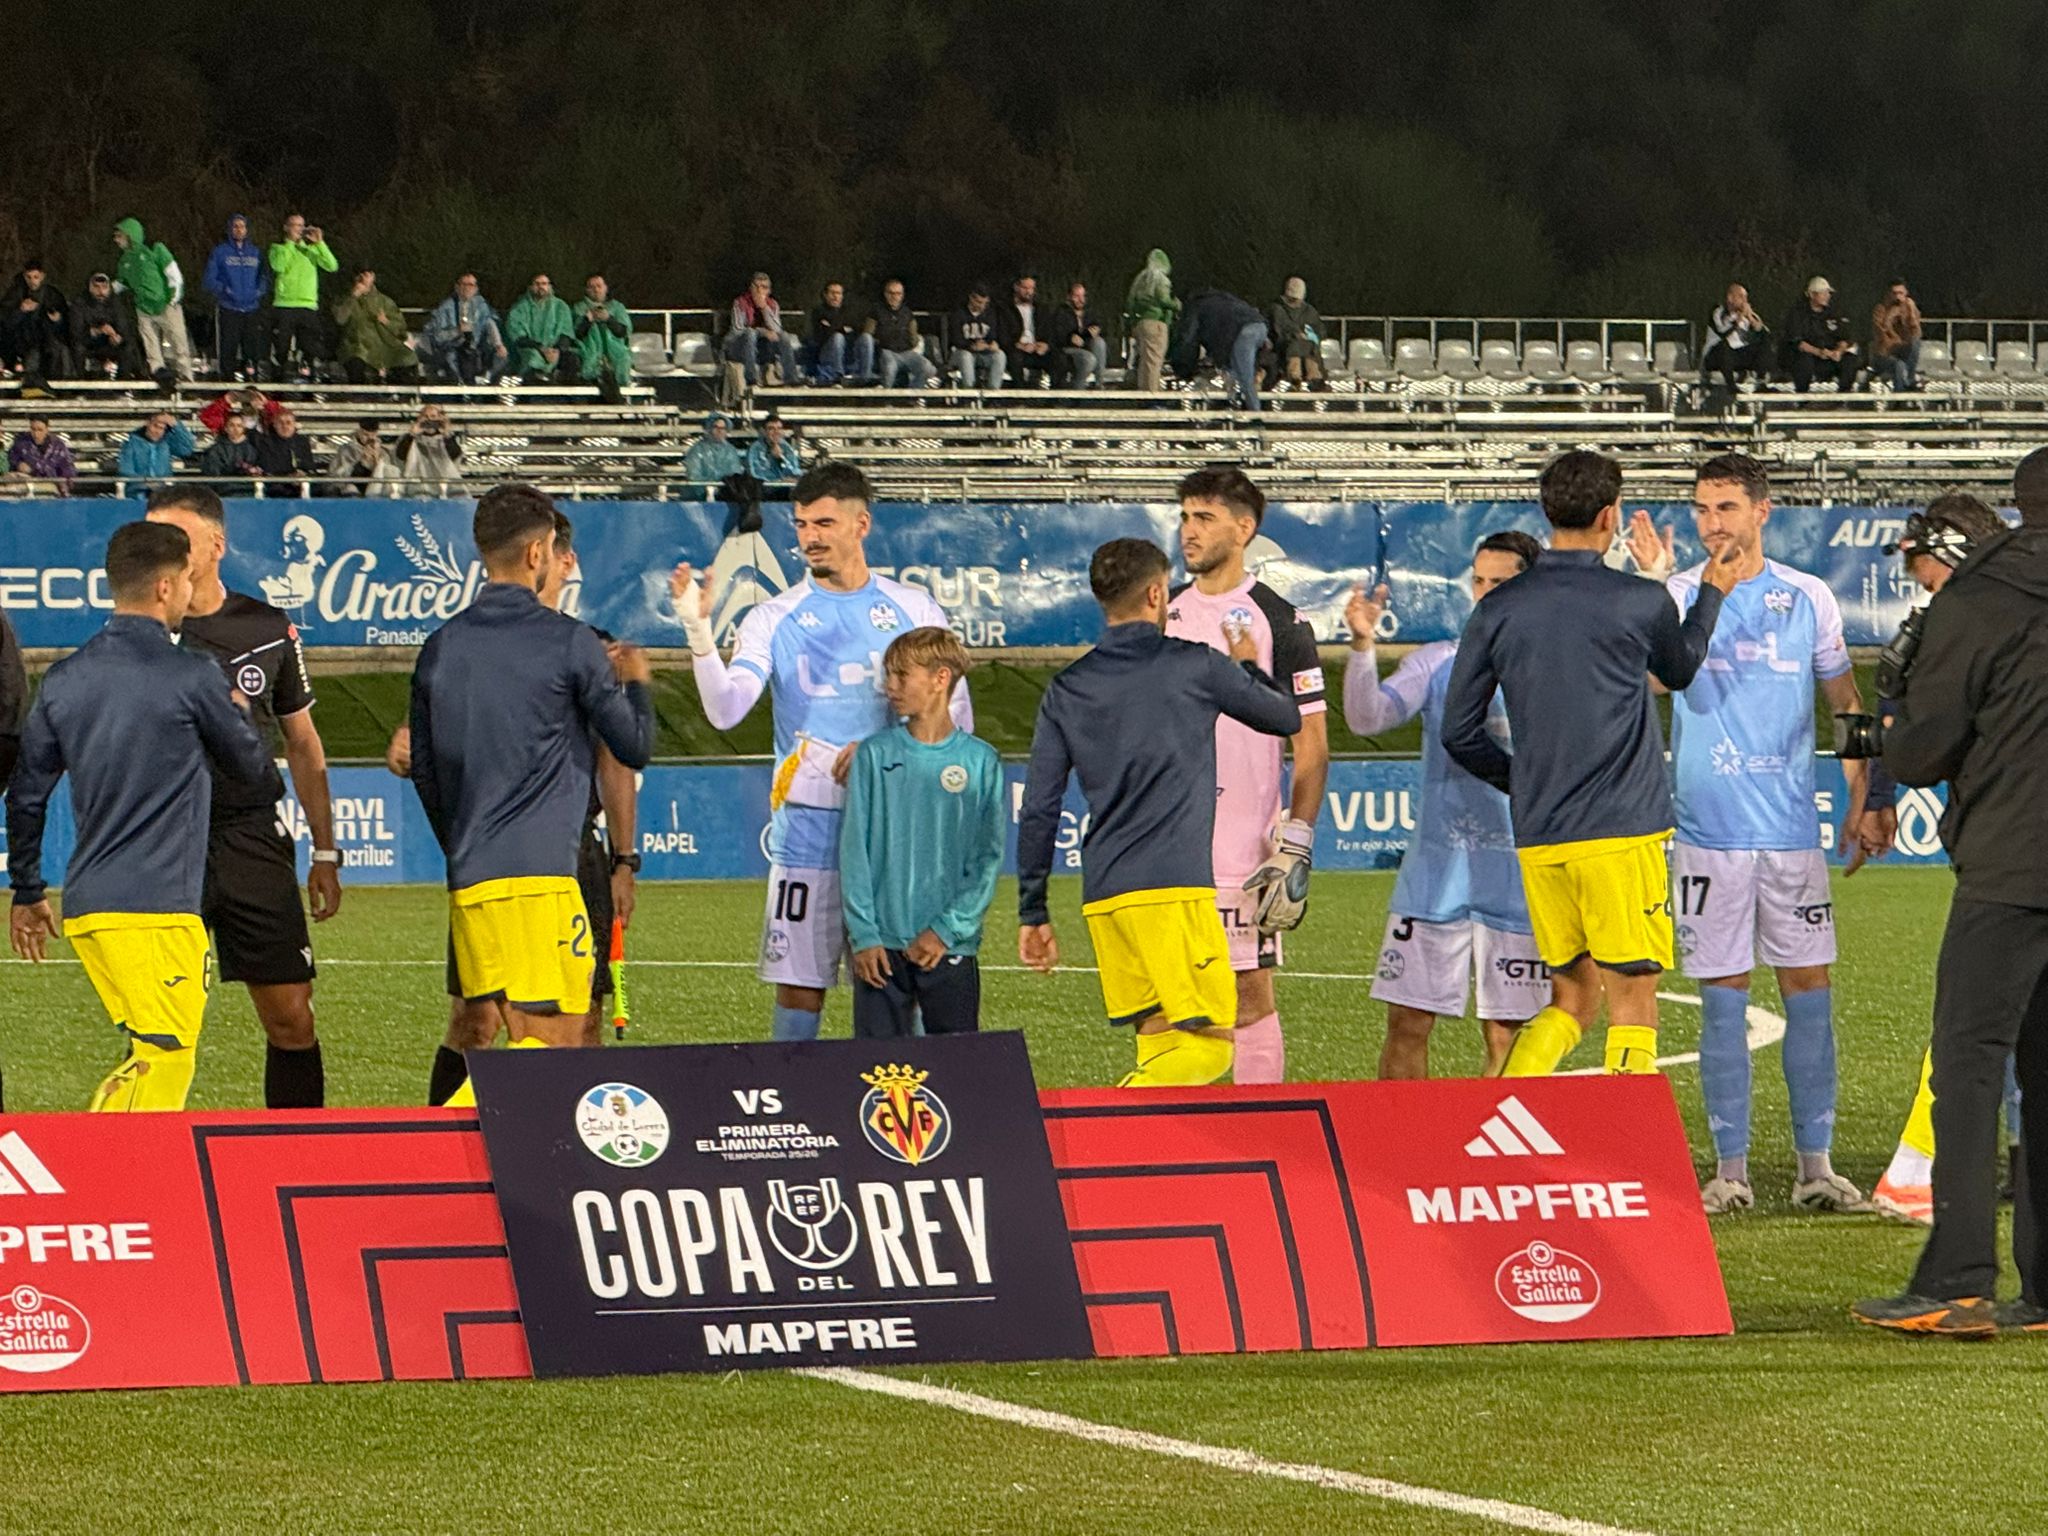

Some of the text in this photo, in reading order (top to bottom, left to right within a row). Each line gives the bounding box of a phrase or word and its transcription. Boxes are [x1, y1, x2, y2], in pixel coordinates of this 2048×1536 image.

[1829, 519, 1907, 547] AUT
[643, 833, 698, 853] PAPEL
[775, 880, 809, 922] 10
[1681, 876, 1711, 916] 17
[572, 914, 587, 957] 2
[732, 1089, 783, 1115] VS
[696, 1135, 840, 1152] ELIMINATORIA
[718, 1123, 812, 1138] PRIMERA
[721, 1152, 787, 1161] TEMPORADA
[1406, 1181, 1650, 1223] MAPFRE
[572, 1177, 993, 1299] COPA DEL REY
[1511, 1264, 1581, 1284] Estrella
[1517, 1283, 1583, 1303] Galicia
[703, 1317, 917, 1355] MAPFRE
